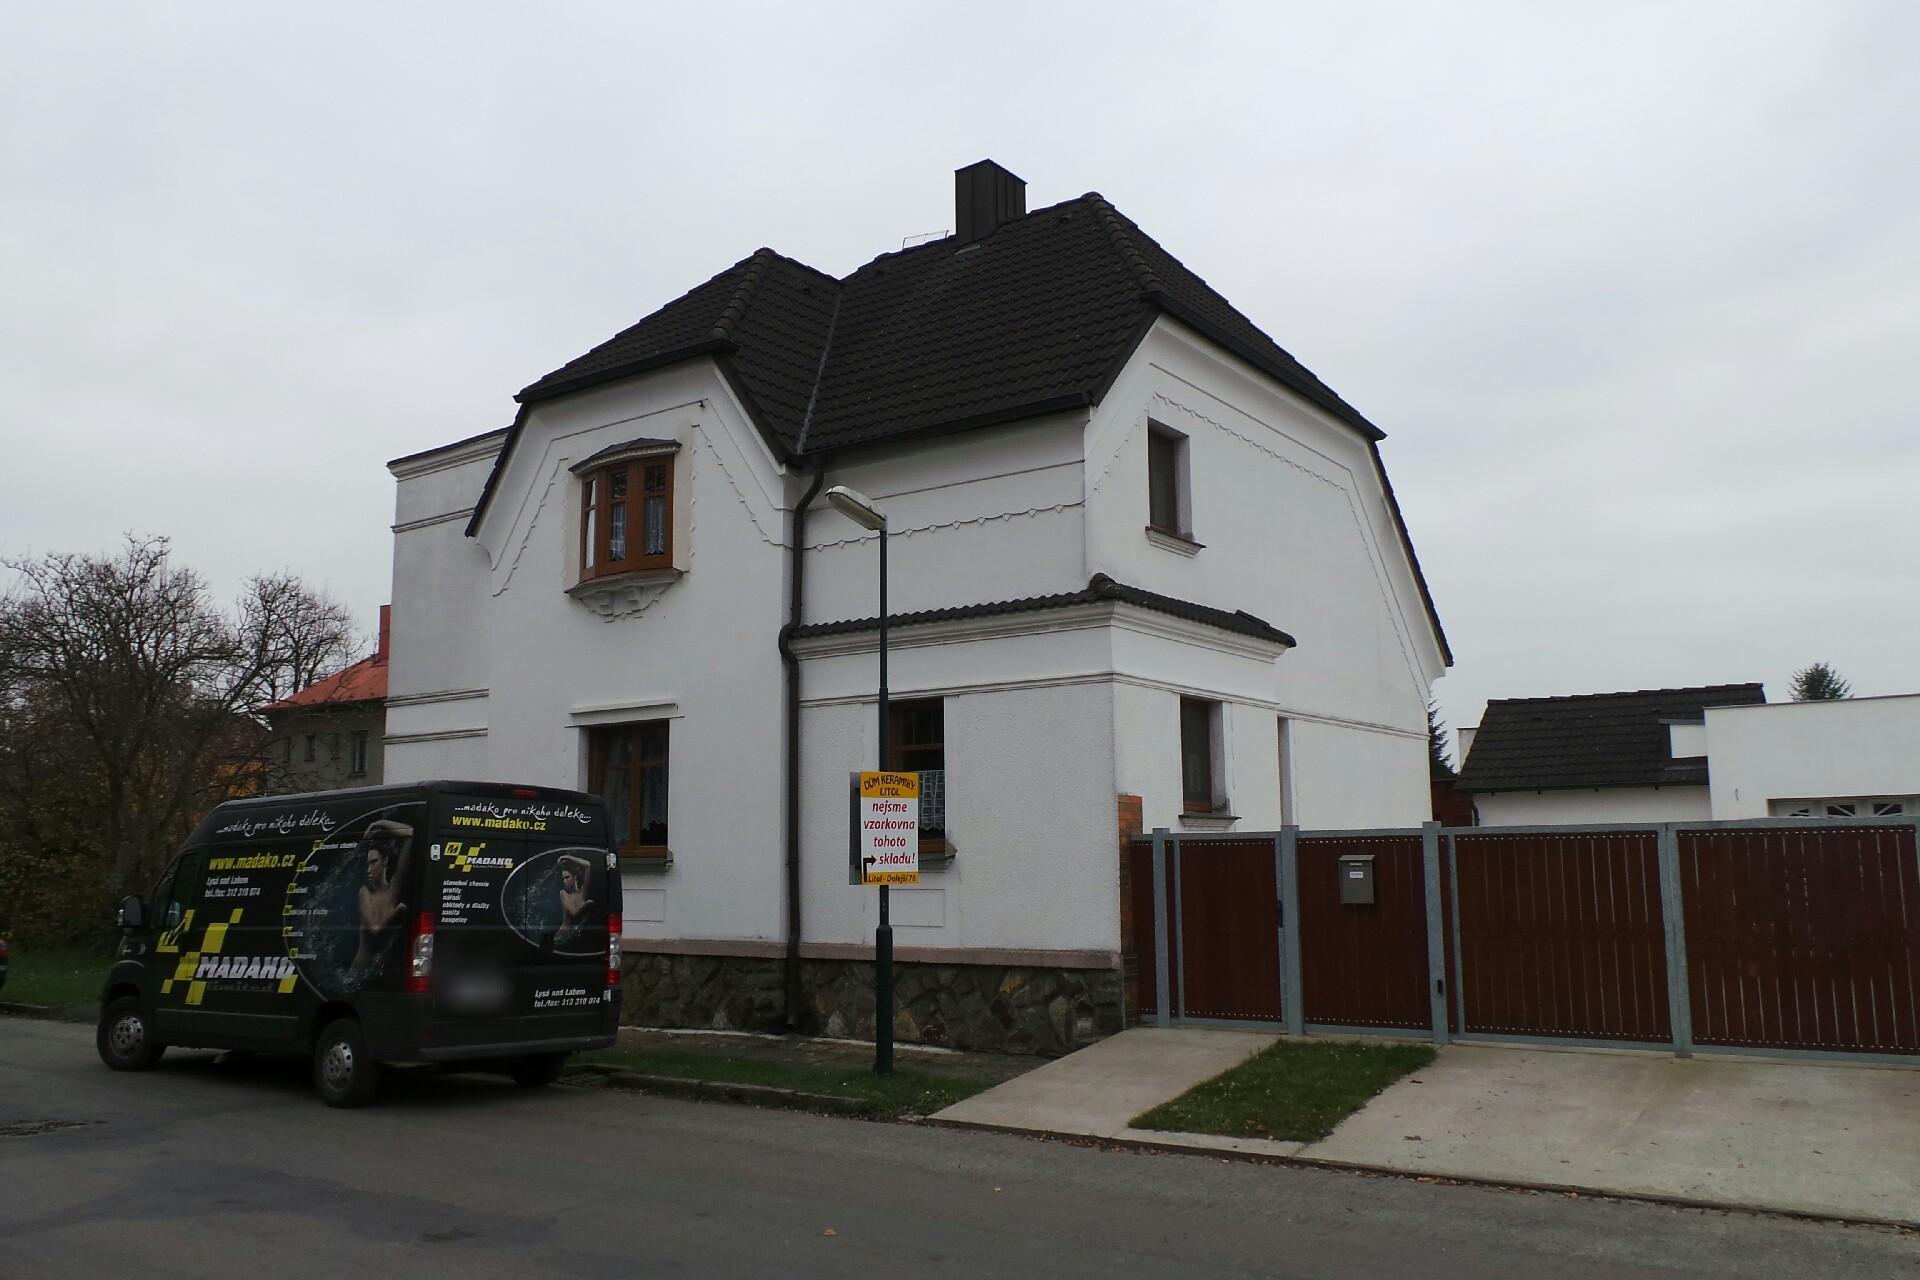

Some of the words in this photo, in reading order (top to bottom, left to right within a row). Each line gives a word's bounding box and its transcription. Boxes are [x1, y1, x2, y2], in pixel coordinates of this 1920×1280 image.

[881, 774, 916, 790] KERAMIKY
[880, 787, 901, 796] LITOL
[872, 800, 908, 815] nejsme
[452, 815, 546, 831] www.madako.cz
[864, 818, 915, 830] vzorkovna
[873, 835, 906, 848] tohoto
[209, 852, 297, 870] www.madako.cz
[466, 857, 513, 866] MADAKO
[879, 852, 915, 865] skladu!
[868, 874, 882, 883] Litol
[195, 956, 296, 979] MADAKO
[561, 998, 574, 1006] 312
